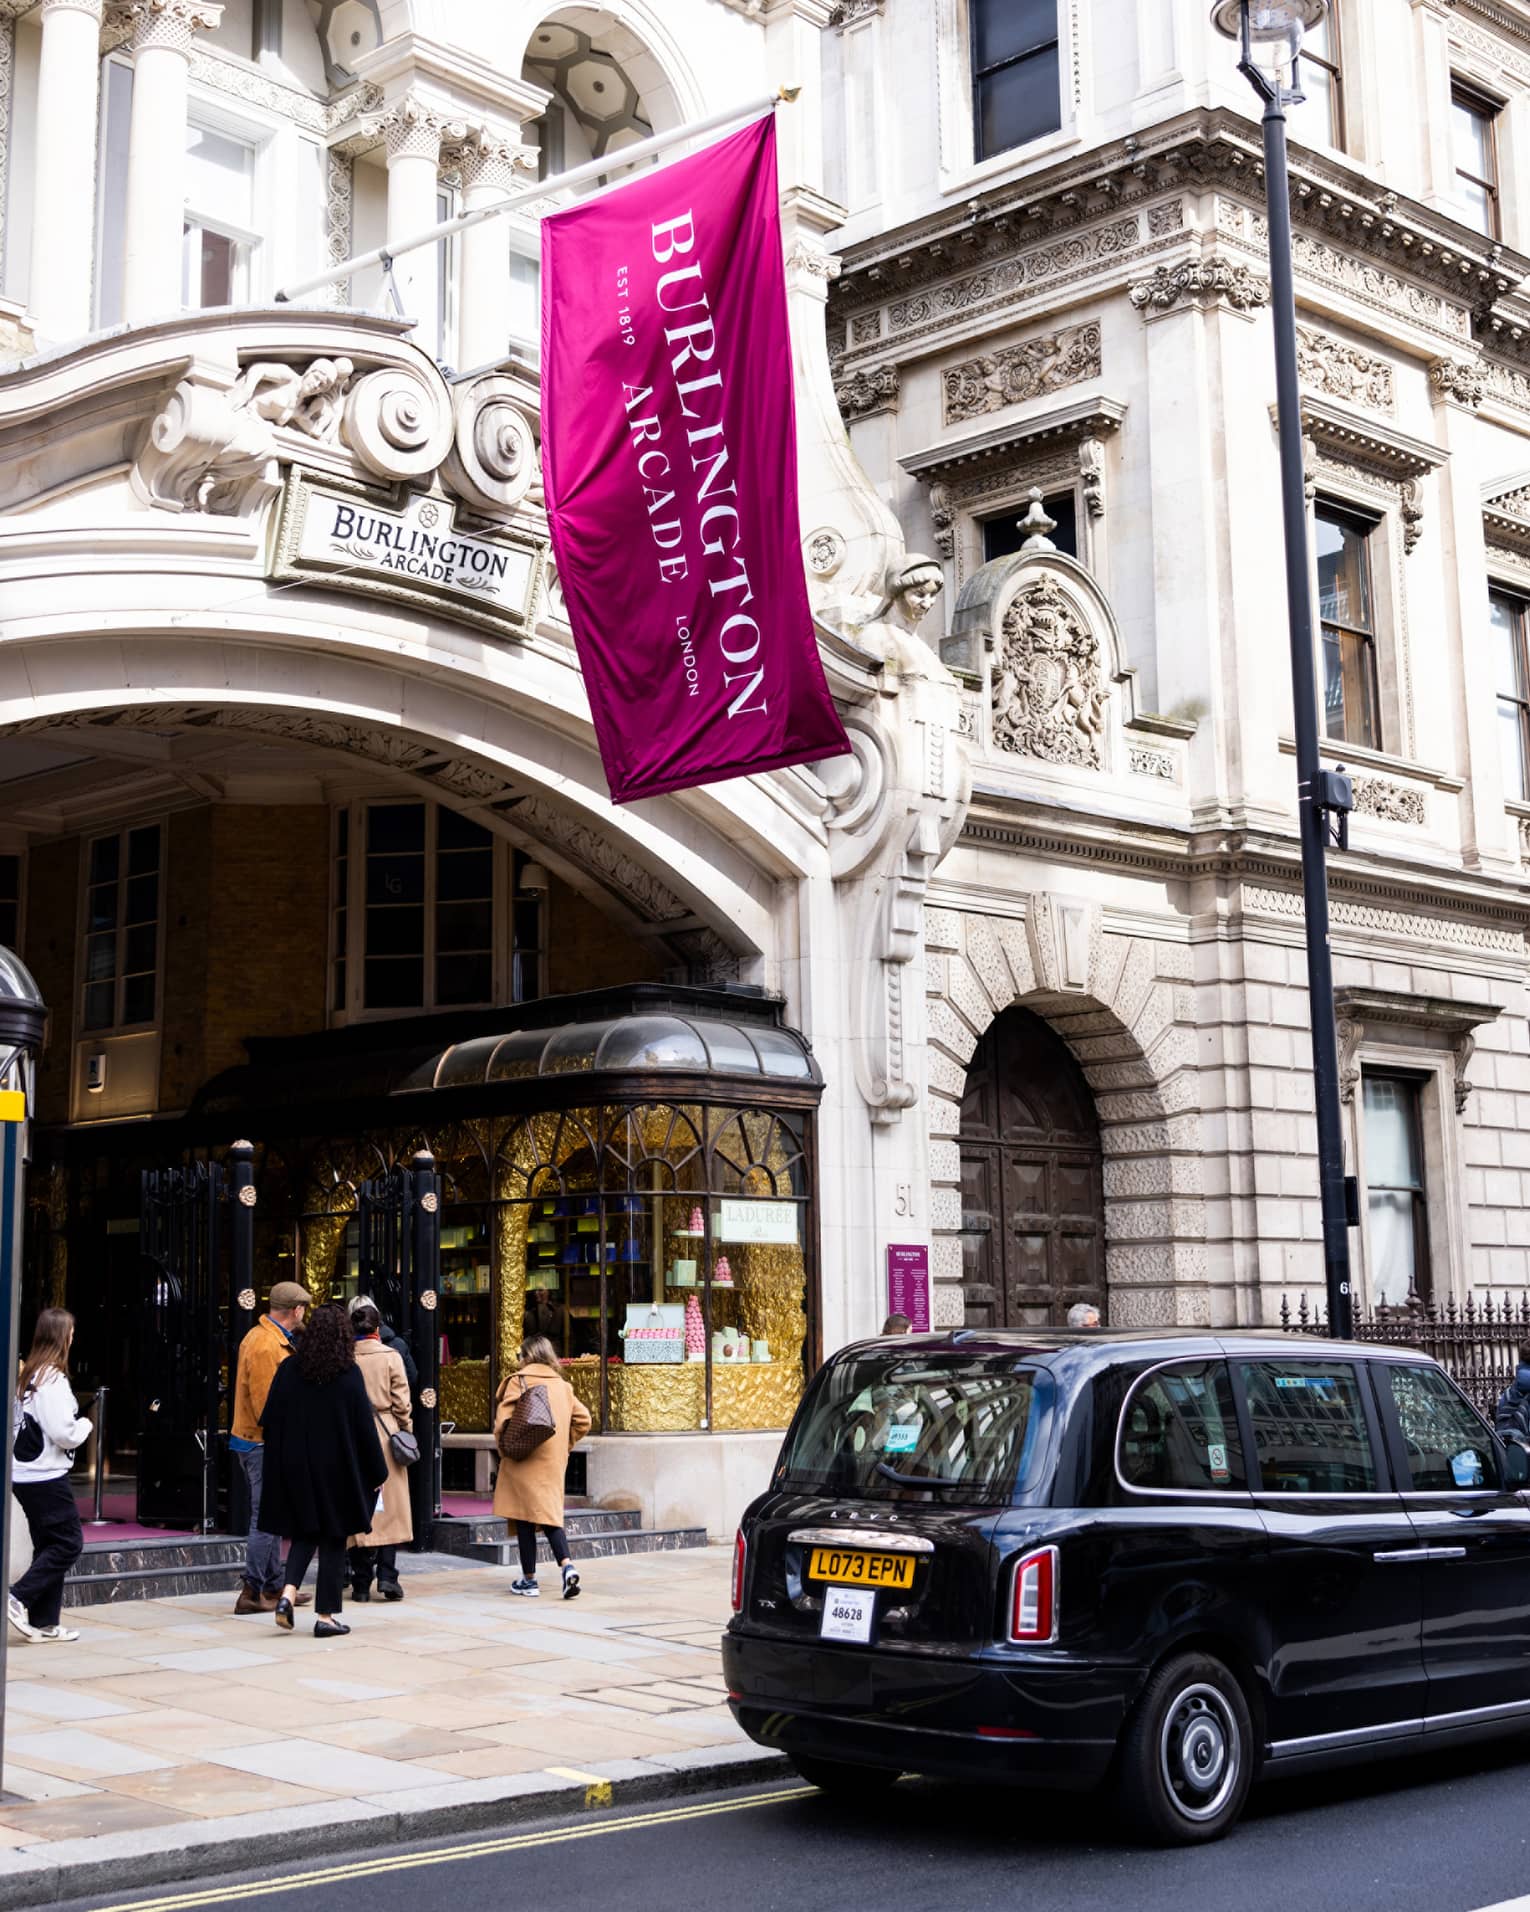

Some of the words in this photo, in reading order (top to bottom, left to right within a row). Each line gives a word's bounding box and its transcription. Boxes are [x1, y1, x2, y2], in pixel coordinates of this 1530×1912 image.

[616, 265, 629, 298] EST
[617, 306, 636, 347] 1819
[621, 381, 690, 584] ARCADE
[651, 208, 768, 720] BURLINGTON
[330, 504, 509, 579] BURLINGTON
[379, 551, 456, 584] ARCADE
[675, 615, 700, 697] LONDON
[867, 1557, 908, 1583] EPN
[758, 1599, 776, 1609] TX
[832, 1606, 862, 1621] 48628
